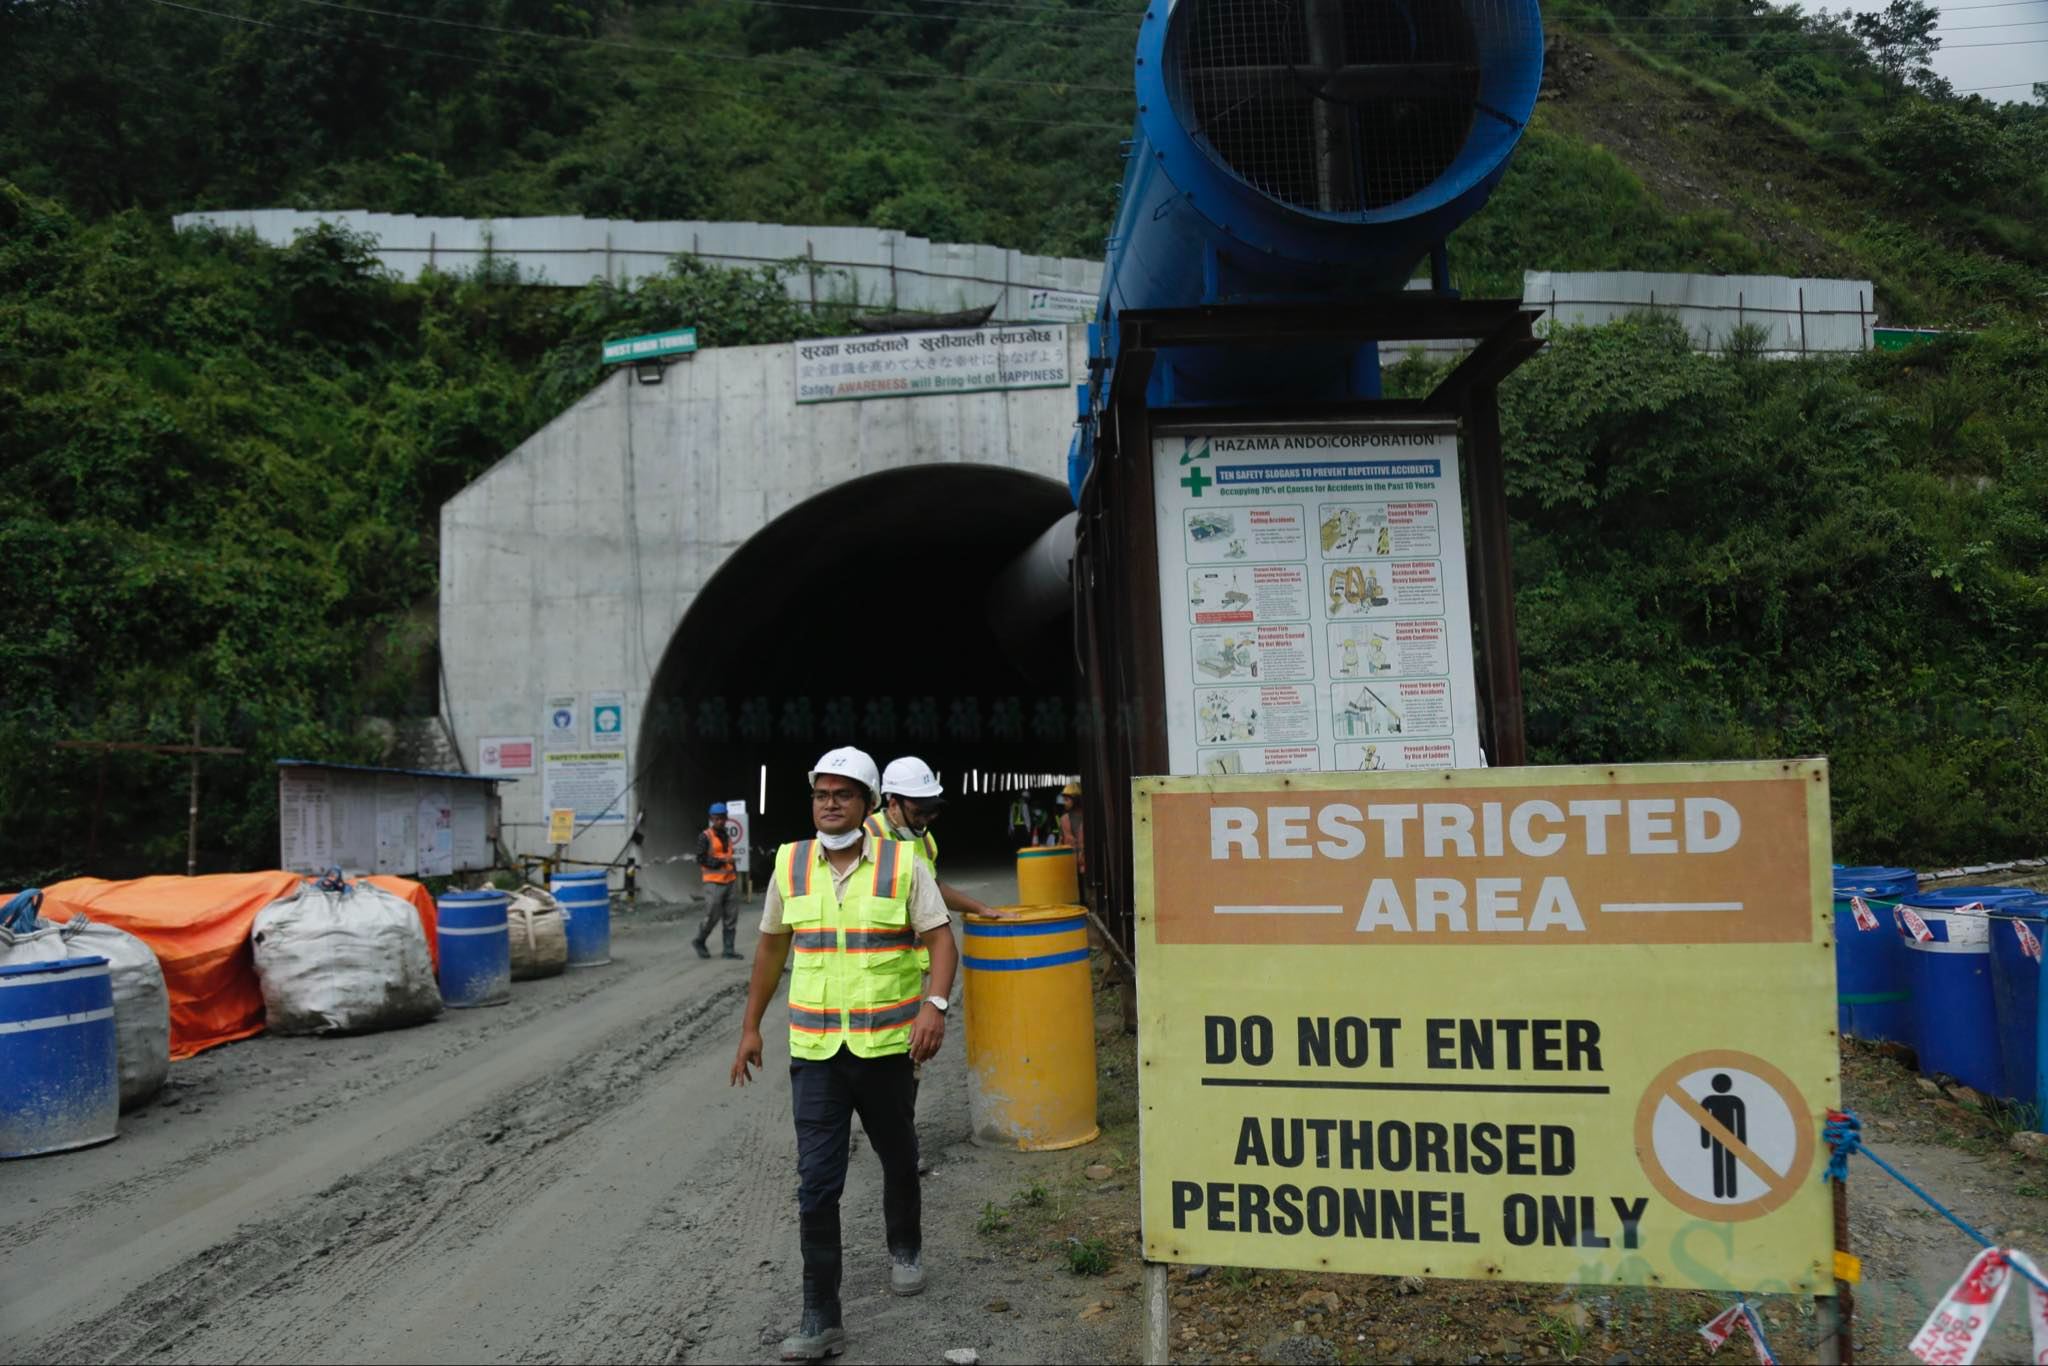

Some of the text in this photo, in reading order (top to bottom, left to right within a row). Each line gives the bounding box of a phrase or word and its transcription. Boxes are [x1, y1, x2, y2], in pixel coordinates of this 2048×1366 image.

[800, 344, 839, 360] सुरक्षा
[800, 383, 835, 396] Safety
[838, 378, 908, 392] AWARENESS
[910, 376, 931, 388] will
[935, 375, 965, 388] Bring
[985, 372, 996, 384] of
[999, 368, 1064, 382] HAPPINESS
[1214, 433, 1434, 452] HAZAMA ANDO CORPORATION
[1220, 464, 1434, 480] TEN SAFETY SLOGANS TO PREVENT REPETITIVE ACCIDENTS
[1220, 487, 1260, 497] Occupying
[1278, 486, 1285, 494] of
[1327, 483, 1364, 492] Accidents
[1365, 483, 1373, 491] in
[1373, 483, 1386, 491] the
[1387, 482, 1404, 490] Past
[1414, 481, 1435, 489] Years
[1210, 797, 1741, 860] RESTRICTED
[1355, 876, 1586, 932] AREA
[1204, 1014, 1604, 1072] DO NOT ENTER
[1234, 1116, 1576, 1176] AUTHORISED
[1171, 1180, 1649, 1250] PERSONNEL ONLY
